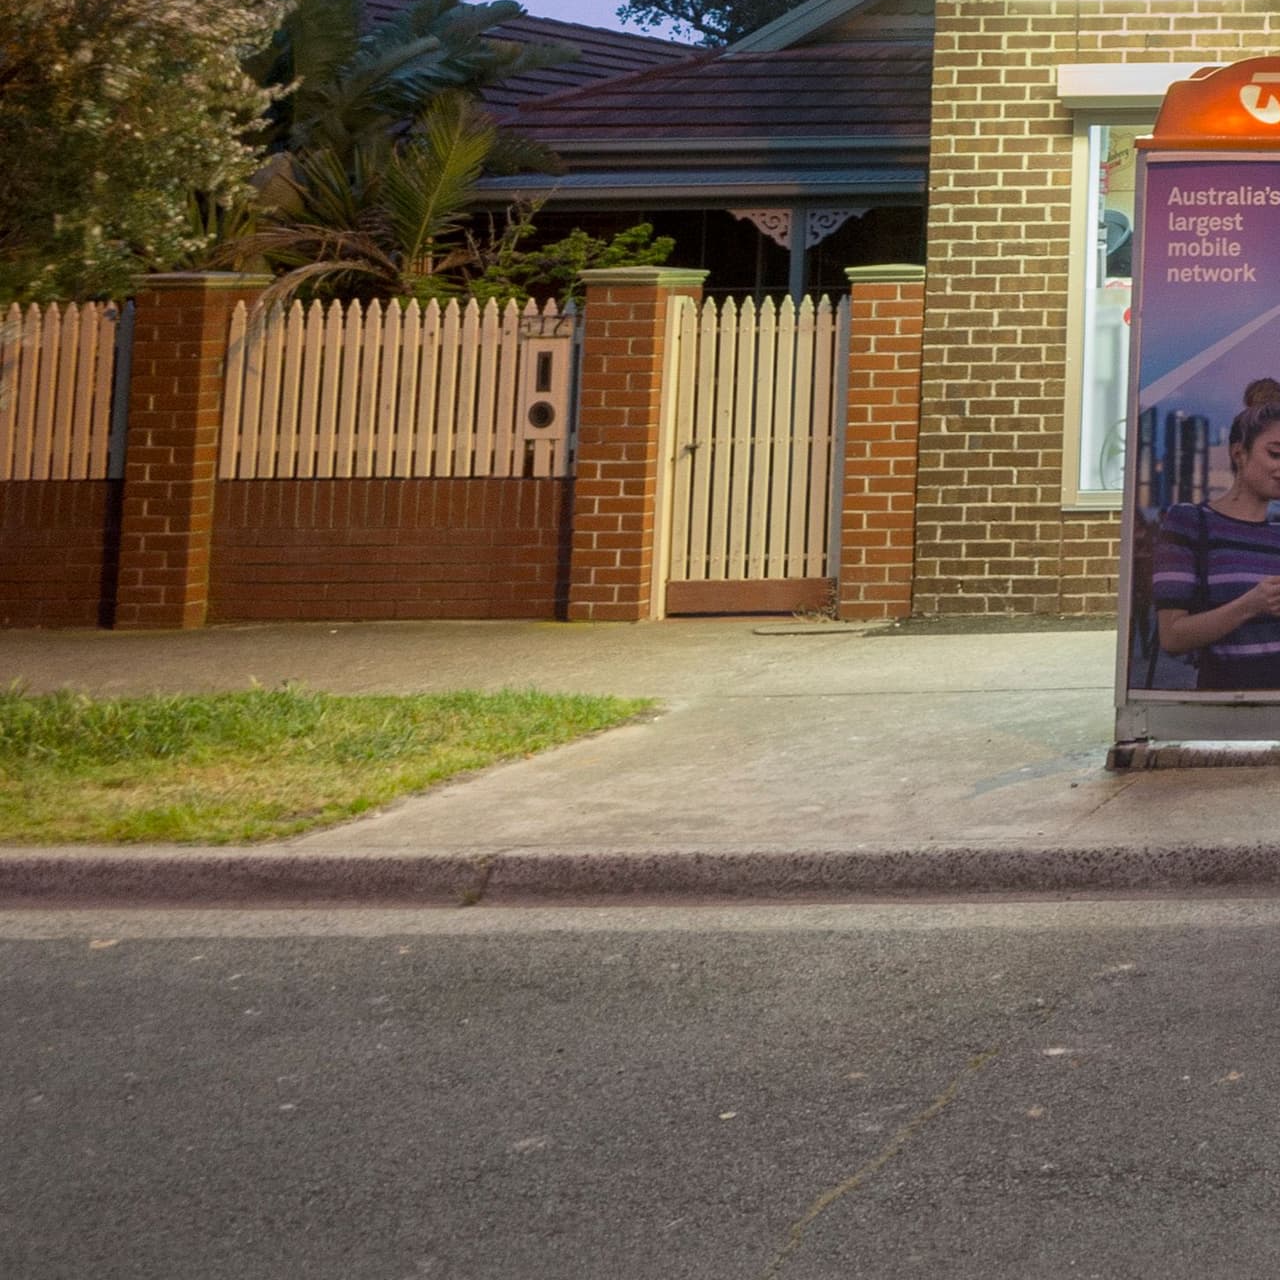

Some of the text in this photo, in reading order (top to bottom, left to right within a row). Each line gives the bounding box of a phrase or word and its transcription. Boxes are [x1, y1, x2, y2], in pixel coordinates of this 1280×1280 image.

[1168, 212, 1244, 237] largest
[1167, 237, 1241, 257] mobile
[1167, 263, 1257, 283] network
